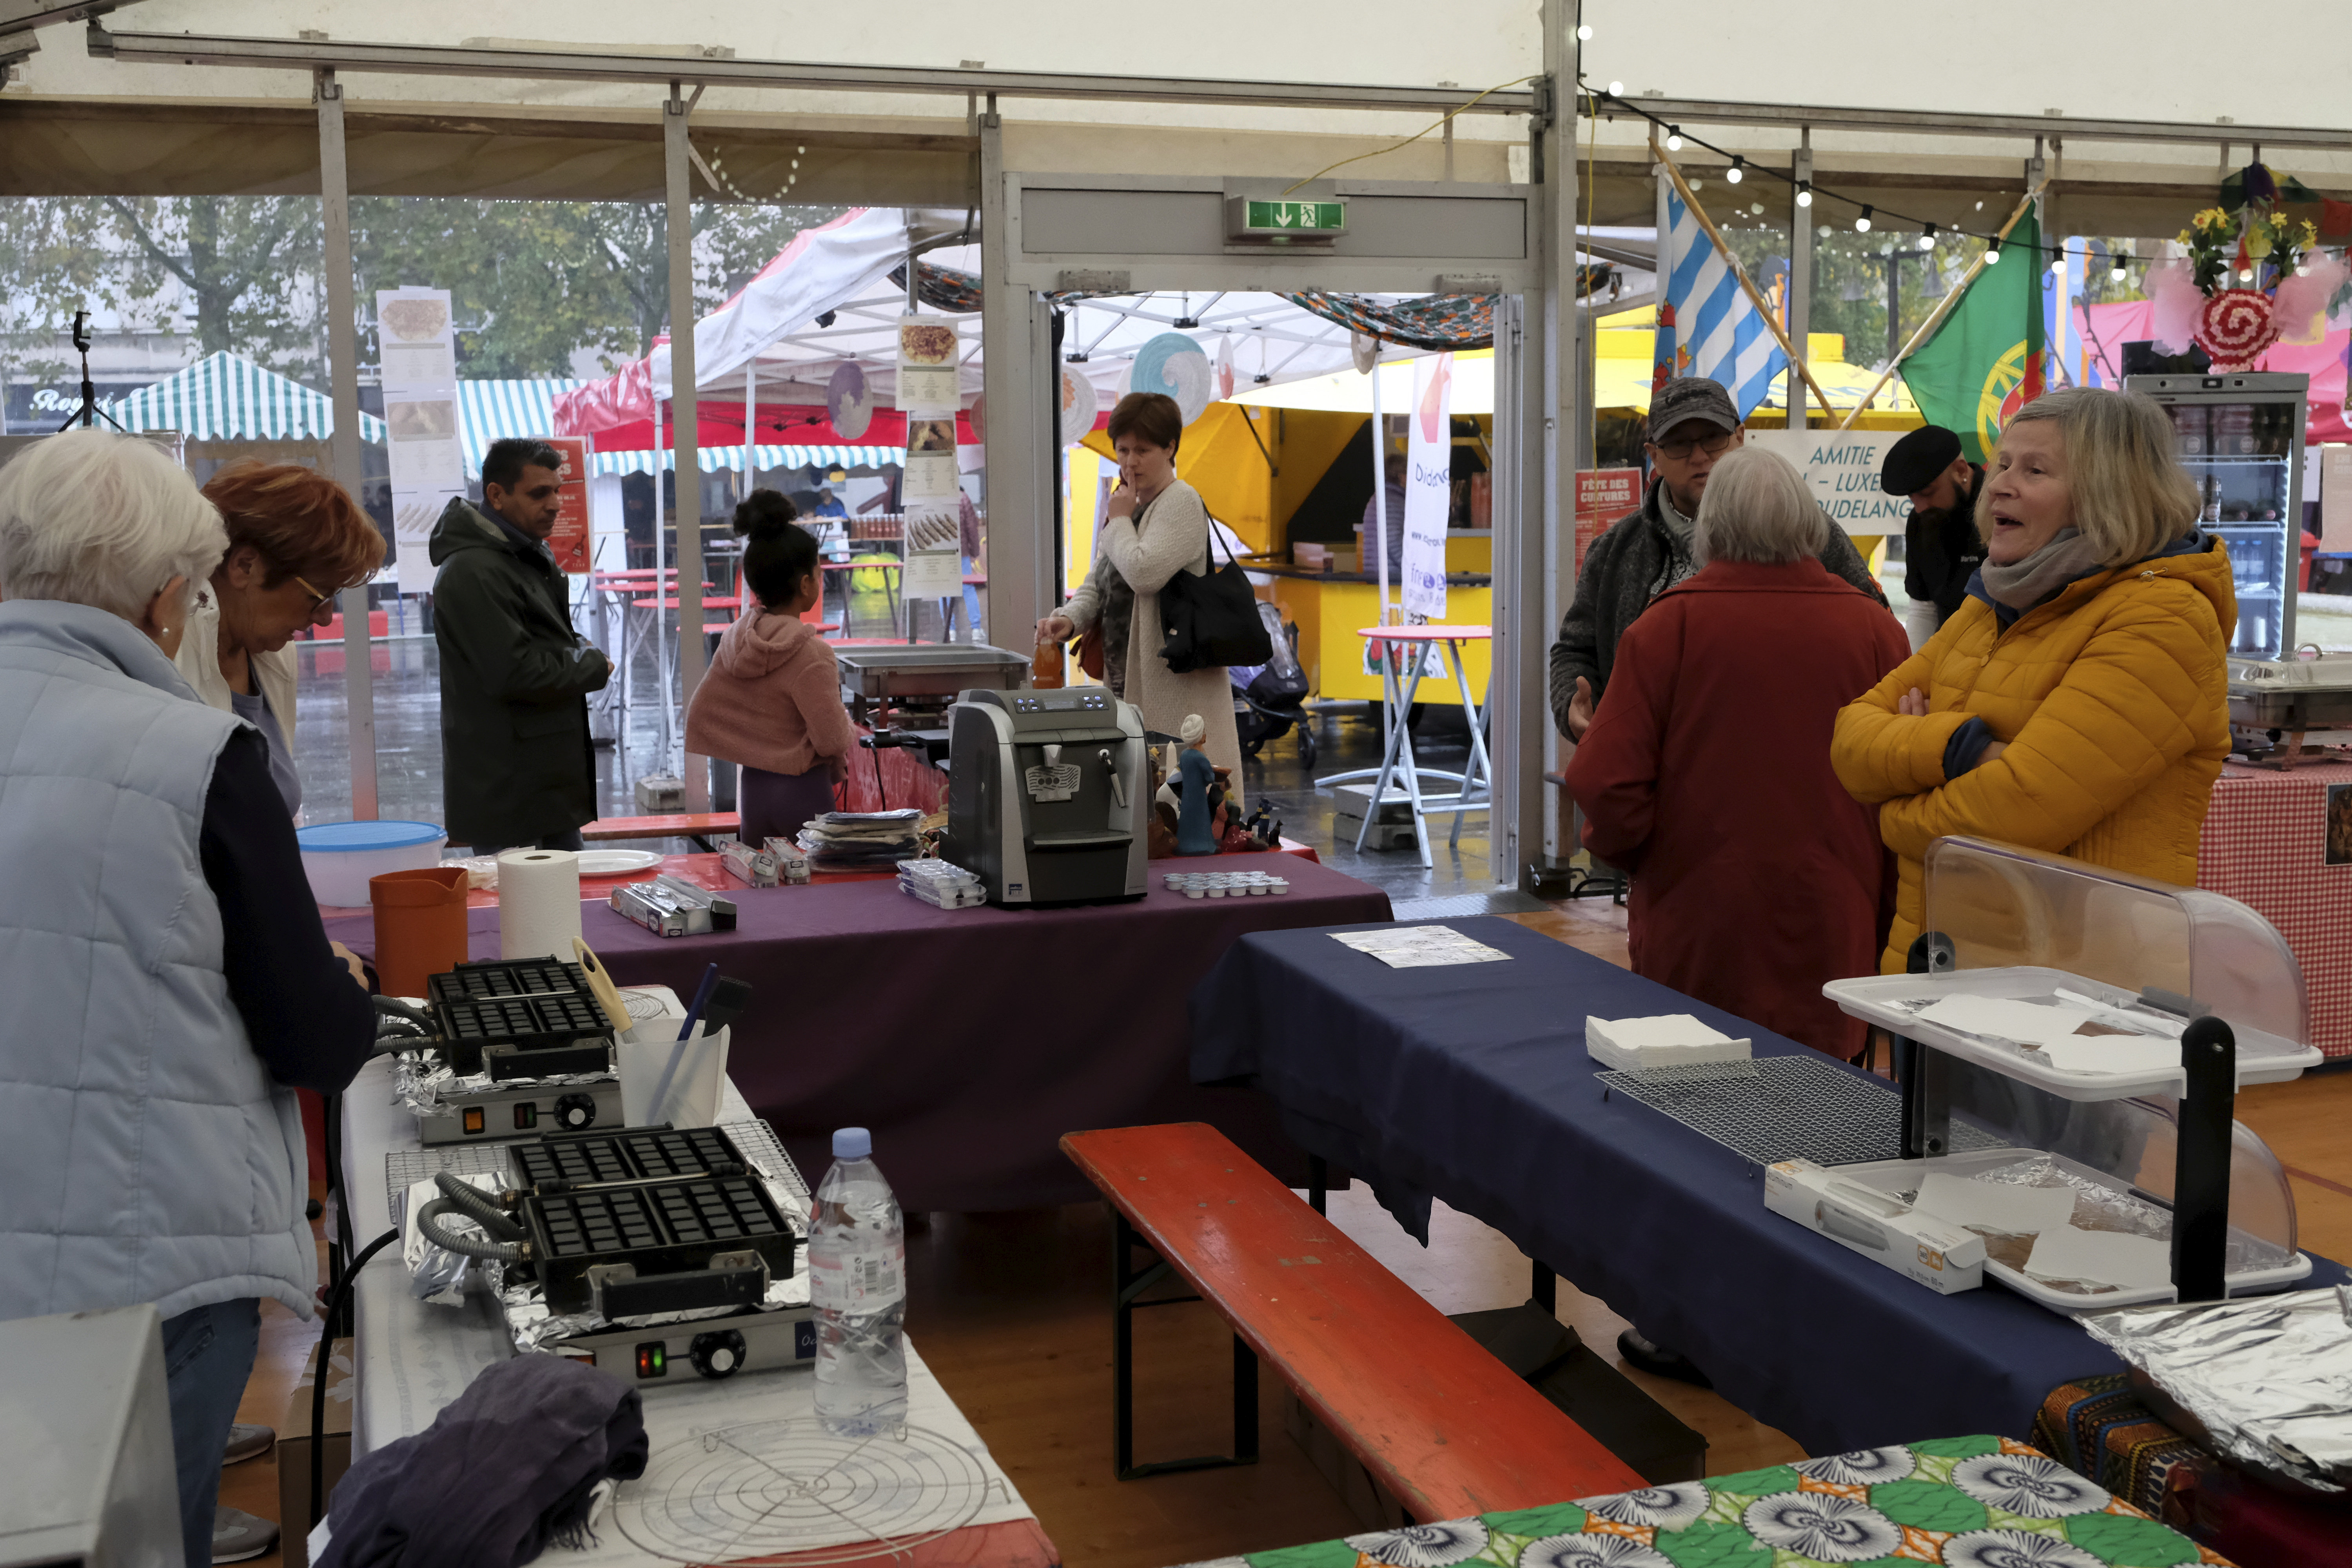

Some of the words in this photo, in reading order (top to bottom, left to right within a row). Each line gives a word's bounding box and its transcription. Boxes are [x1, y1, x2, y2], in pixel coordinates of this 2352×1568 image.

[1809, 446, 1876, 465] AMITIE
[1582, 479, 1607, 490] FÊTE
[1610, 479, 1629, 489] DES
[1835, 473, 1882, 492] LUXE
[1581, 491, 1631, 503] CULTURES
[1919, 1250, 1928, 1259] 365
